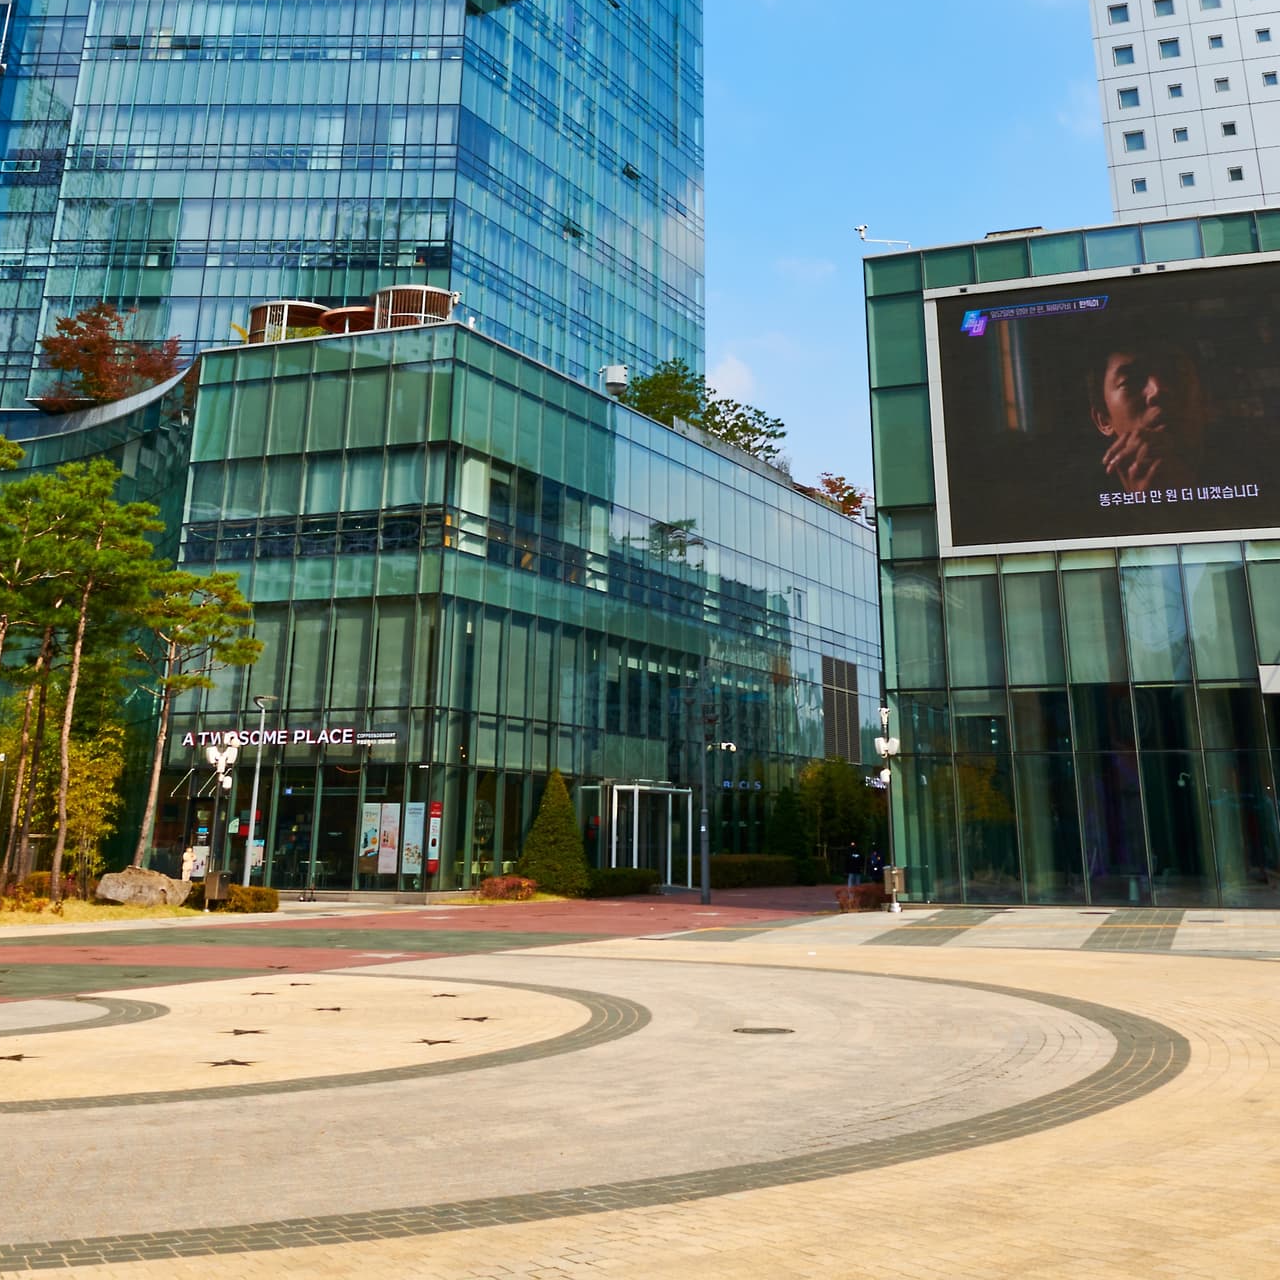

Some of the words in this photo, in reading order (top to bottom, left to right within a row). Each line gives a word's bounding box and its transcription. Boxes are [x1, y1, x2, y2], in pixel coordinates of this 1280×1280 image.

[1099, 491, 1147, 507] 똥주보다
[1150, 490, 1162, 503] 만
[1165, 489, 1178, 502] 원
[1181, 488, 1193, 501] 더
[1197, 484, 1260, 500] 내겠습니다
[182, 732, 195, 746] A
[293, 728, 353, 745] PLACE
